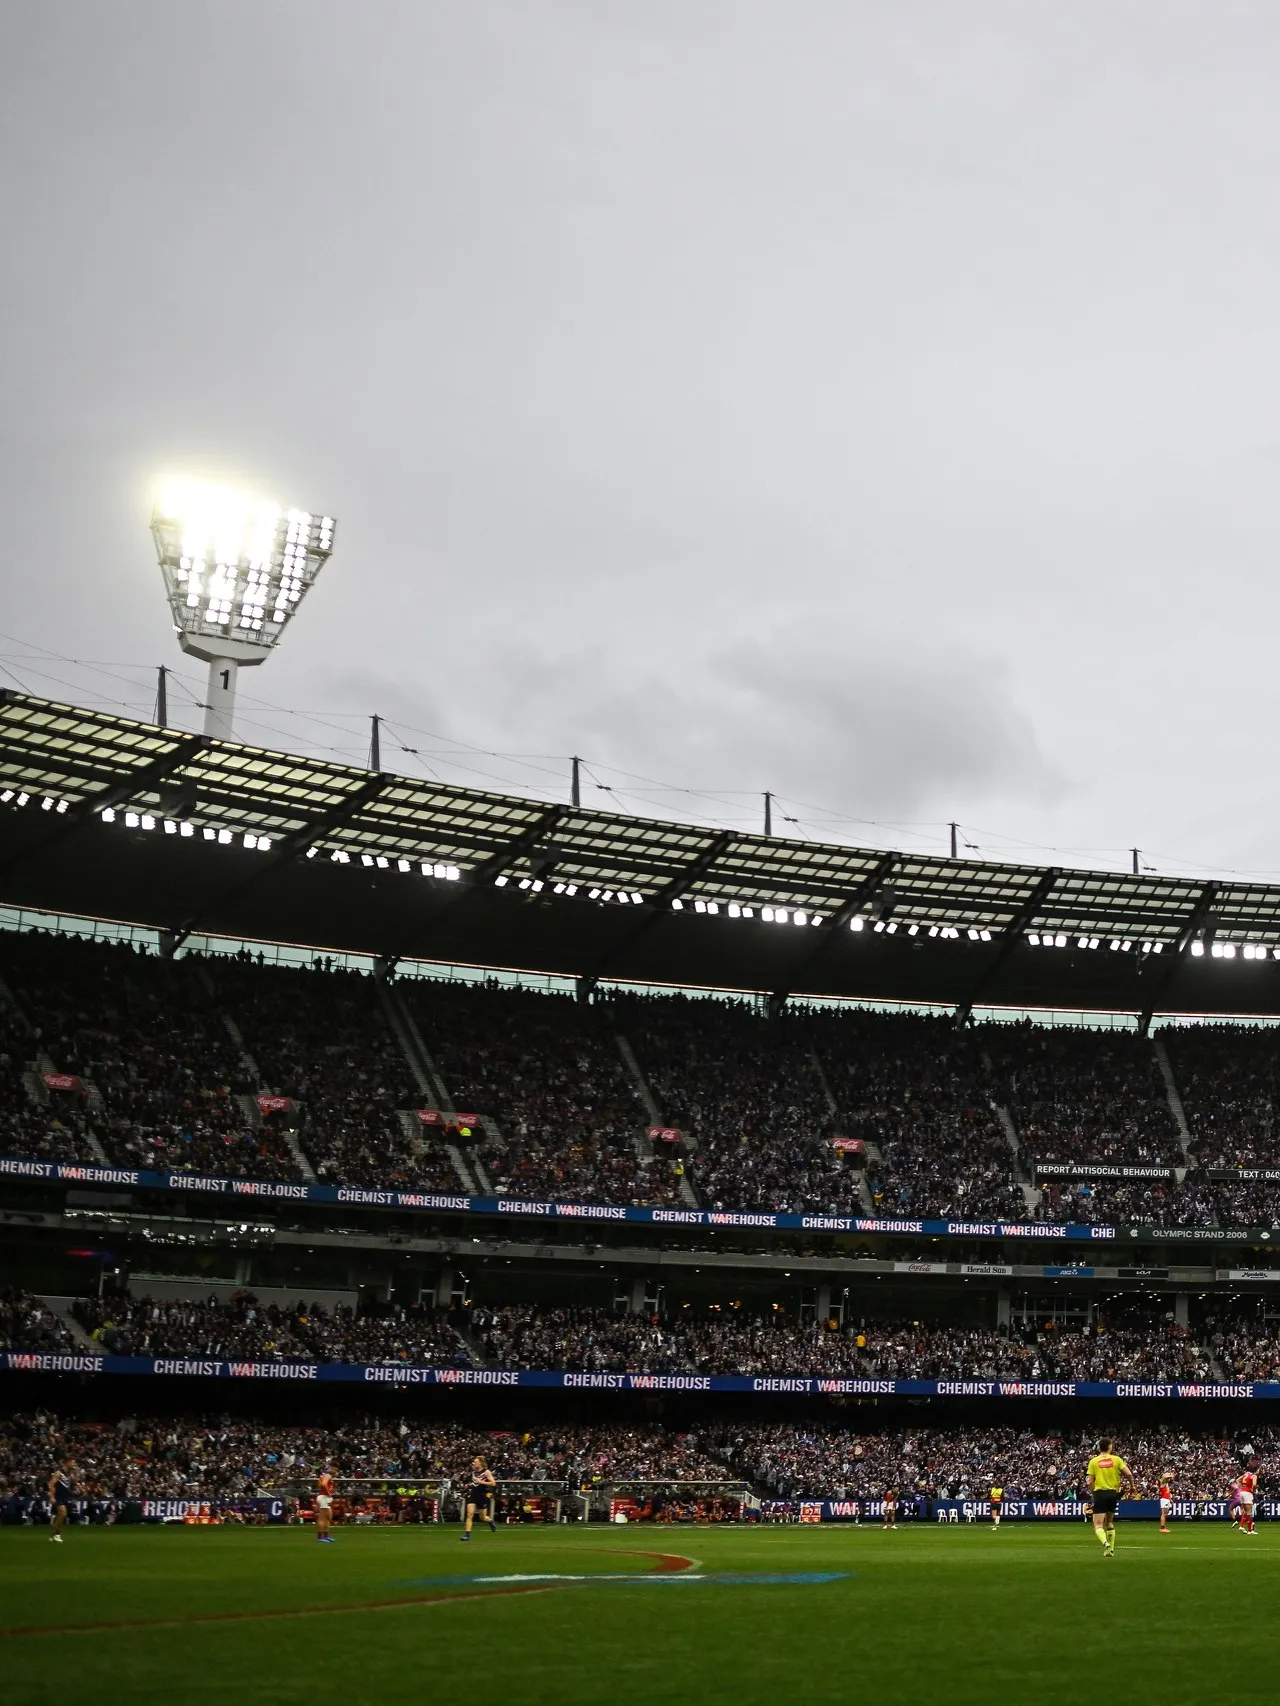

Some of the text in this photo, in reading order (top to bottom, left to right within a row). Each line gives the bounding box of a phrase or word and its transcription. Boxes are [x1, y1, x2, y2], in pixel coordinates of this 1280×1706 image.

[220, 669, 229, 690] 1
[58, 1168, 138, 1182] WAREHOUSE
[1037, 1166, 1170, 1177] REPORT ANTISOCIAL BEHAVIOUR
[170, 1177, 308, 1197] CHEMIST WAREHOUSE
[338, 1190, 470, 1208] CHEMIST WAREHOUSE
[498, 1202, 626, 1218] CHEMIST WAREHOUSE
[653, 1211, 776, 1225] CHEMIST WAREHOUSE
[803, 1218, 922, 1231] CHEMIST WAREHOUSE
[949, 1224, 1065, 1236] CHEMIST WAREHOUSE
[1152, 1230, 1192, 1238] OLYMPIC
[1194, 1231, 1224, 1239] STAND
[967, 1266, 1006, 1274] Herald Sun
[8, 1355, 102, 1370] WAREHOUSE
[154, 1361, 317, 1378] CHEMIST WAREHOUSE
[365, 1368, 518, 1384] CHEMIST WAREHOUSE
[564, 1375, 710, 1388] CHEMIST WAREHOUSE
[754, 1379, 895, 1392] CHEMIST WAREHOUSE
[938, 1383, 1075, 1395] CHEMIST WAREHOUSE
[1117, 1385, 1253, 1397] CHEMIST WAREHOUSE
